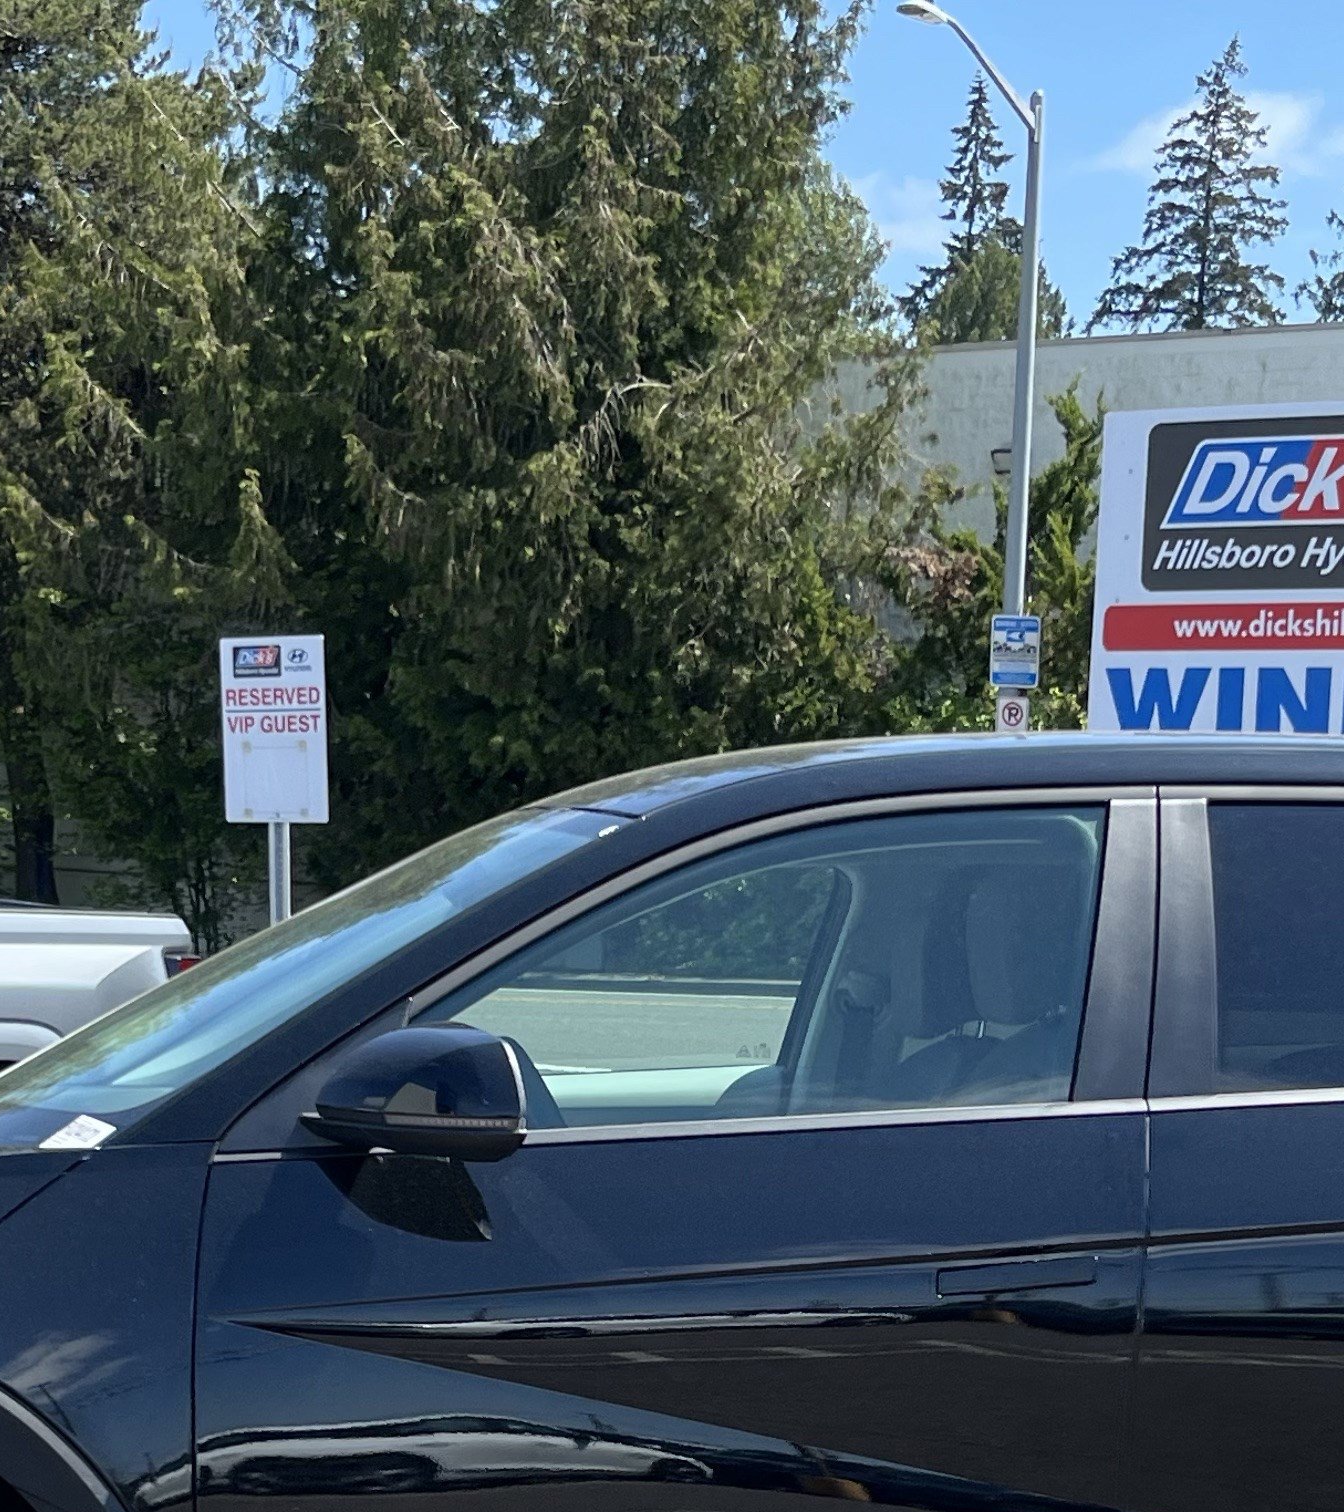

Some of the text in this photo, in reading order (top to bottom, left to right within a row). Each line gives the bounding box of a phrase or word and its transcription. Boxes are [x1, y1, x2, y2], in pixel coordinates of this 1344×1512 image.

[1152, 537, 1296, 570] Hillsboro
[225, 686, 320, 707] RESERVED
[227, 714, 321, 734] VIP GUEST
